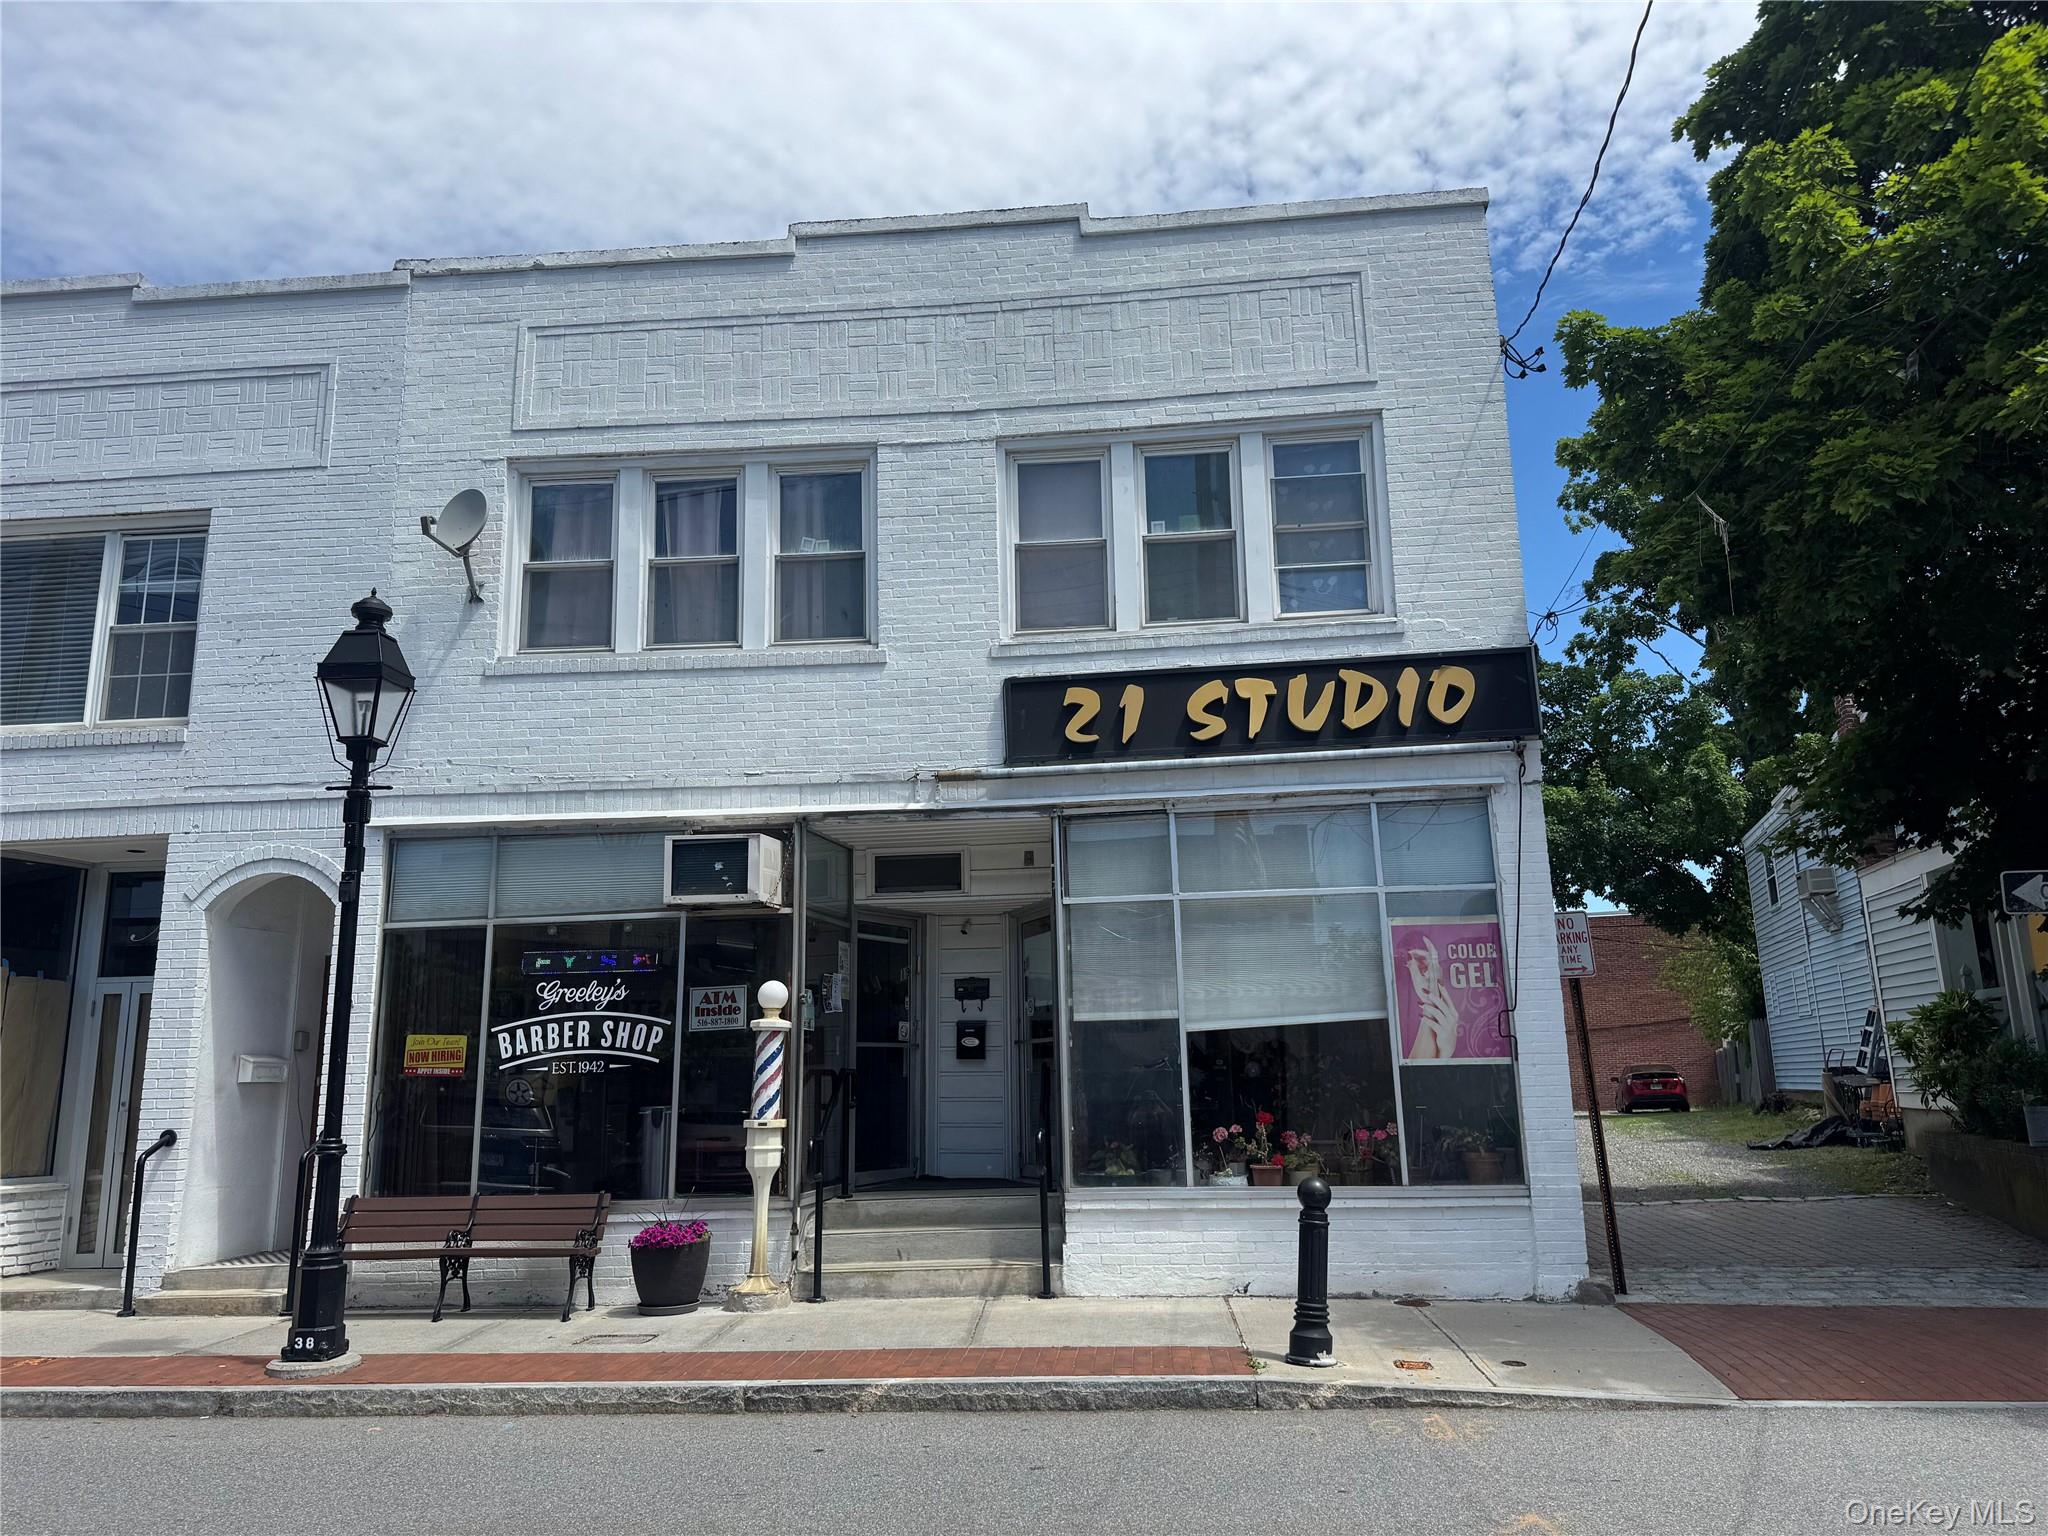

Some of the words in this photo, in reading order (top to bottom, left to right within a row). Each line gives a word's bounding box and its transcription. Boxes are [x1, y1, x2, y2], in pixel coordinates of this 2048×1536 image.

[1063, 684, 1144, 744] 21
[1187, 665, 1476, 741] STUDIO
[1557, 918, 1574, 930] NO
[1557, 931, 1588, 945] RKING
[1447, 943, 1497, 959] COLOR
[1562, 945, 1578, 954] ANY
[1560, 955, 1583, 964] TIME
[1450, 961, 1498, 989] GEL
[536, 978, 630, 1011] Greeley's
[700, 990, 737, 1005] ATM
[498, 1020, 590, 1059] BARBER
[601, 1020, 664, 1052] SHOP
[409, 1050, 430, 1063] NOW
[431, 1049, 462, 1062] HIRING
[294, 1337, 315, 1349] 38
